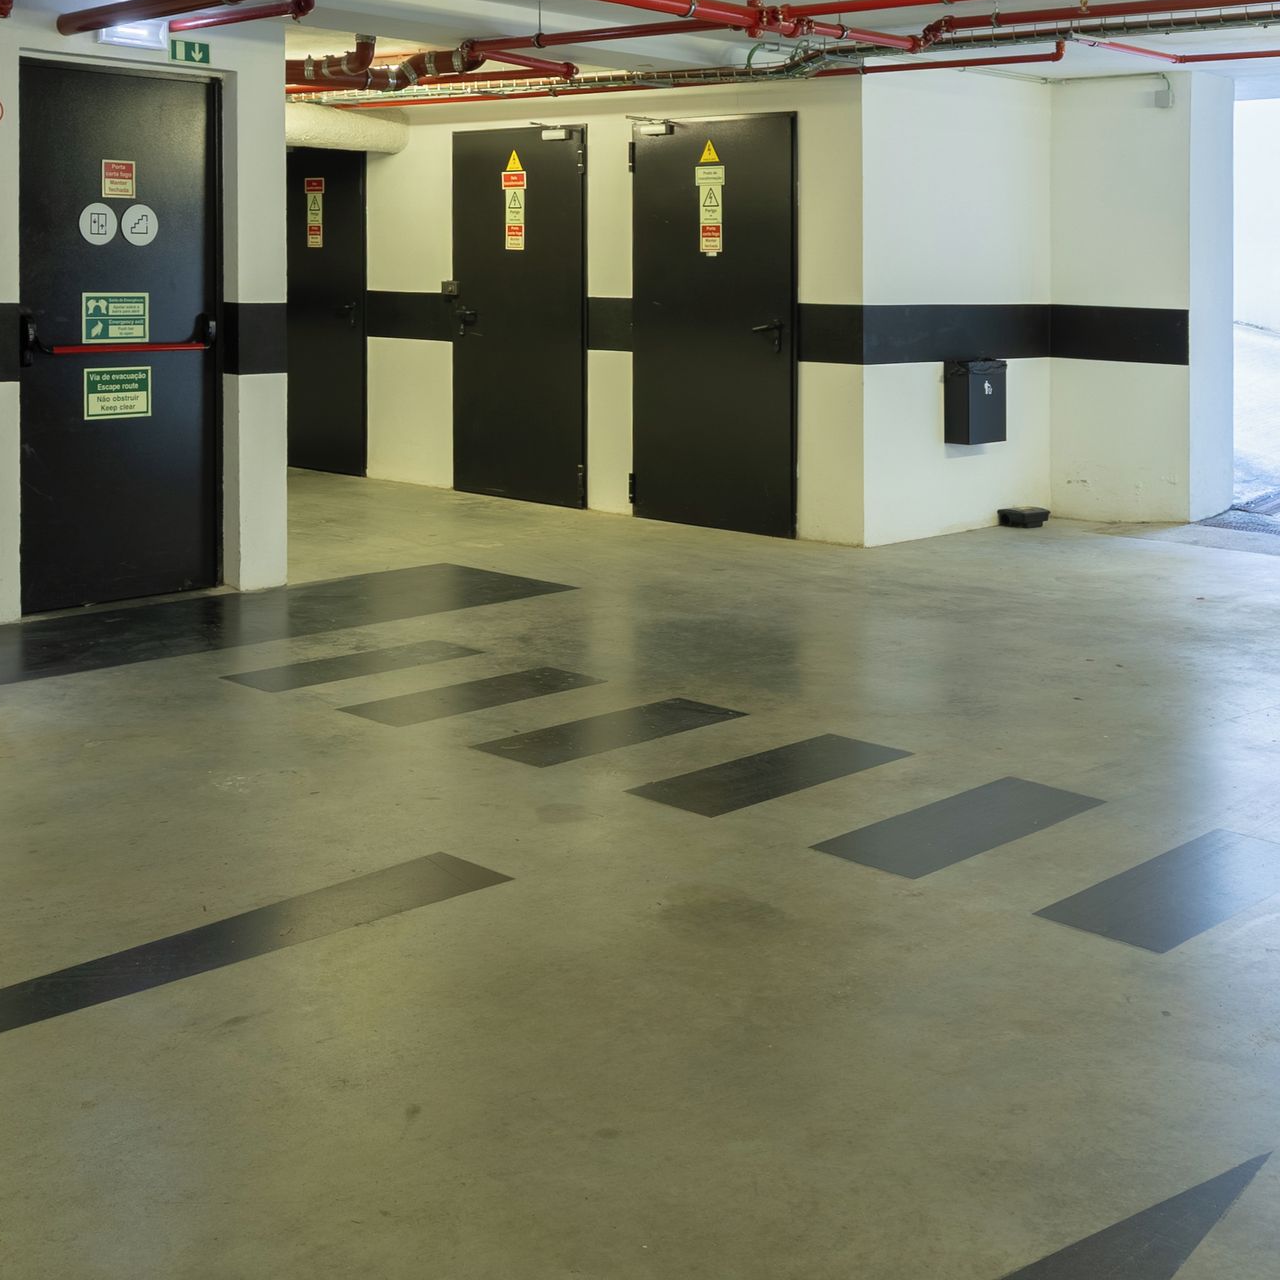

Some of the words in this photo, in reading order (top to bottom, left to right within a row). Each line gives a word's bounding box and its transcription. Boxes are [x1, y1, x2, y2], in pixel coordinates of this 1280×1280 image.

[89, 373, 101, 381] Via
[102, 373, 110, 381] de
[112, 372, 146, 381] evacuação
[97, 383, 120, 391] Escape
[96, 395, 110, 403] Não
[112, 394, 139, 402] obstruir
[100, 404, 118, 412] Keep
